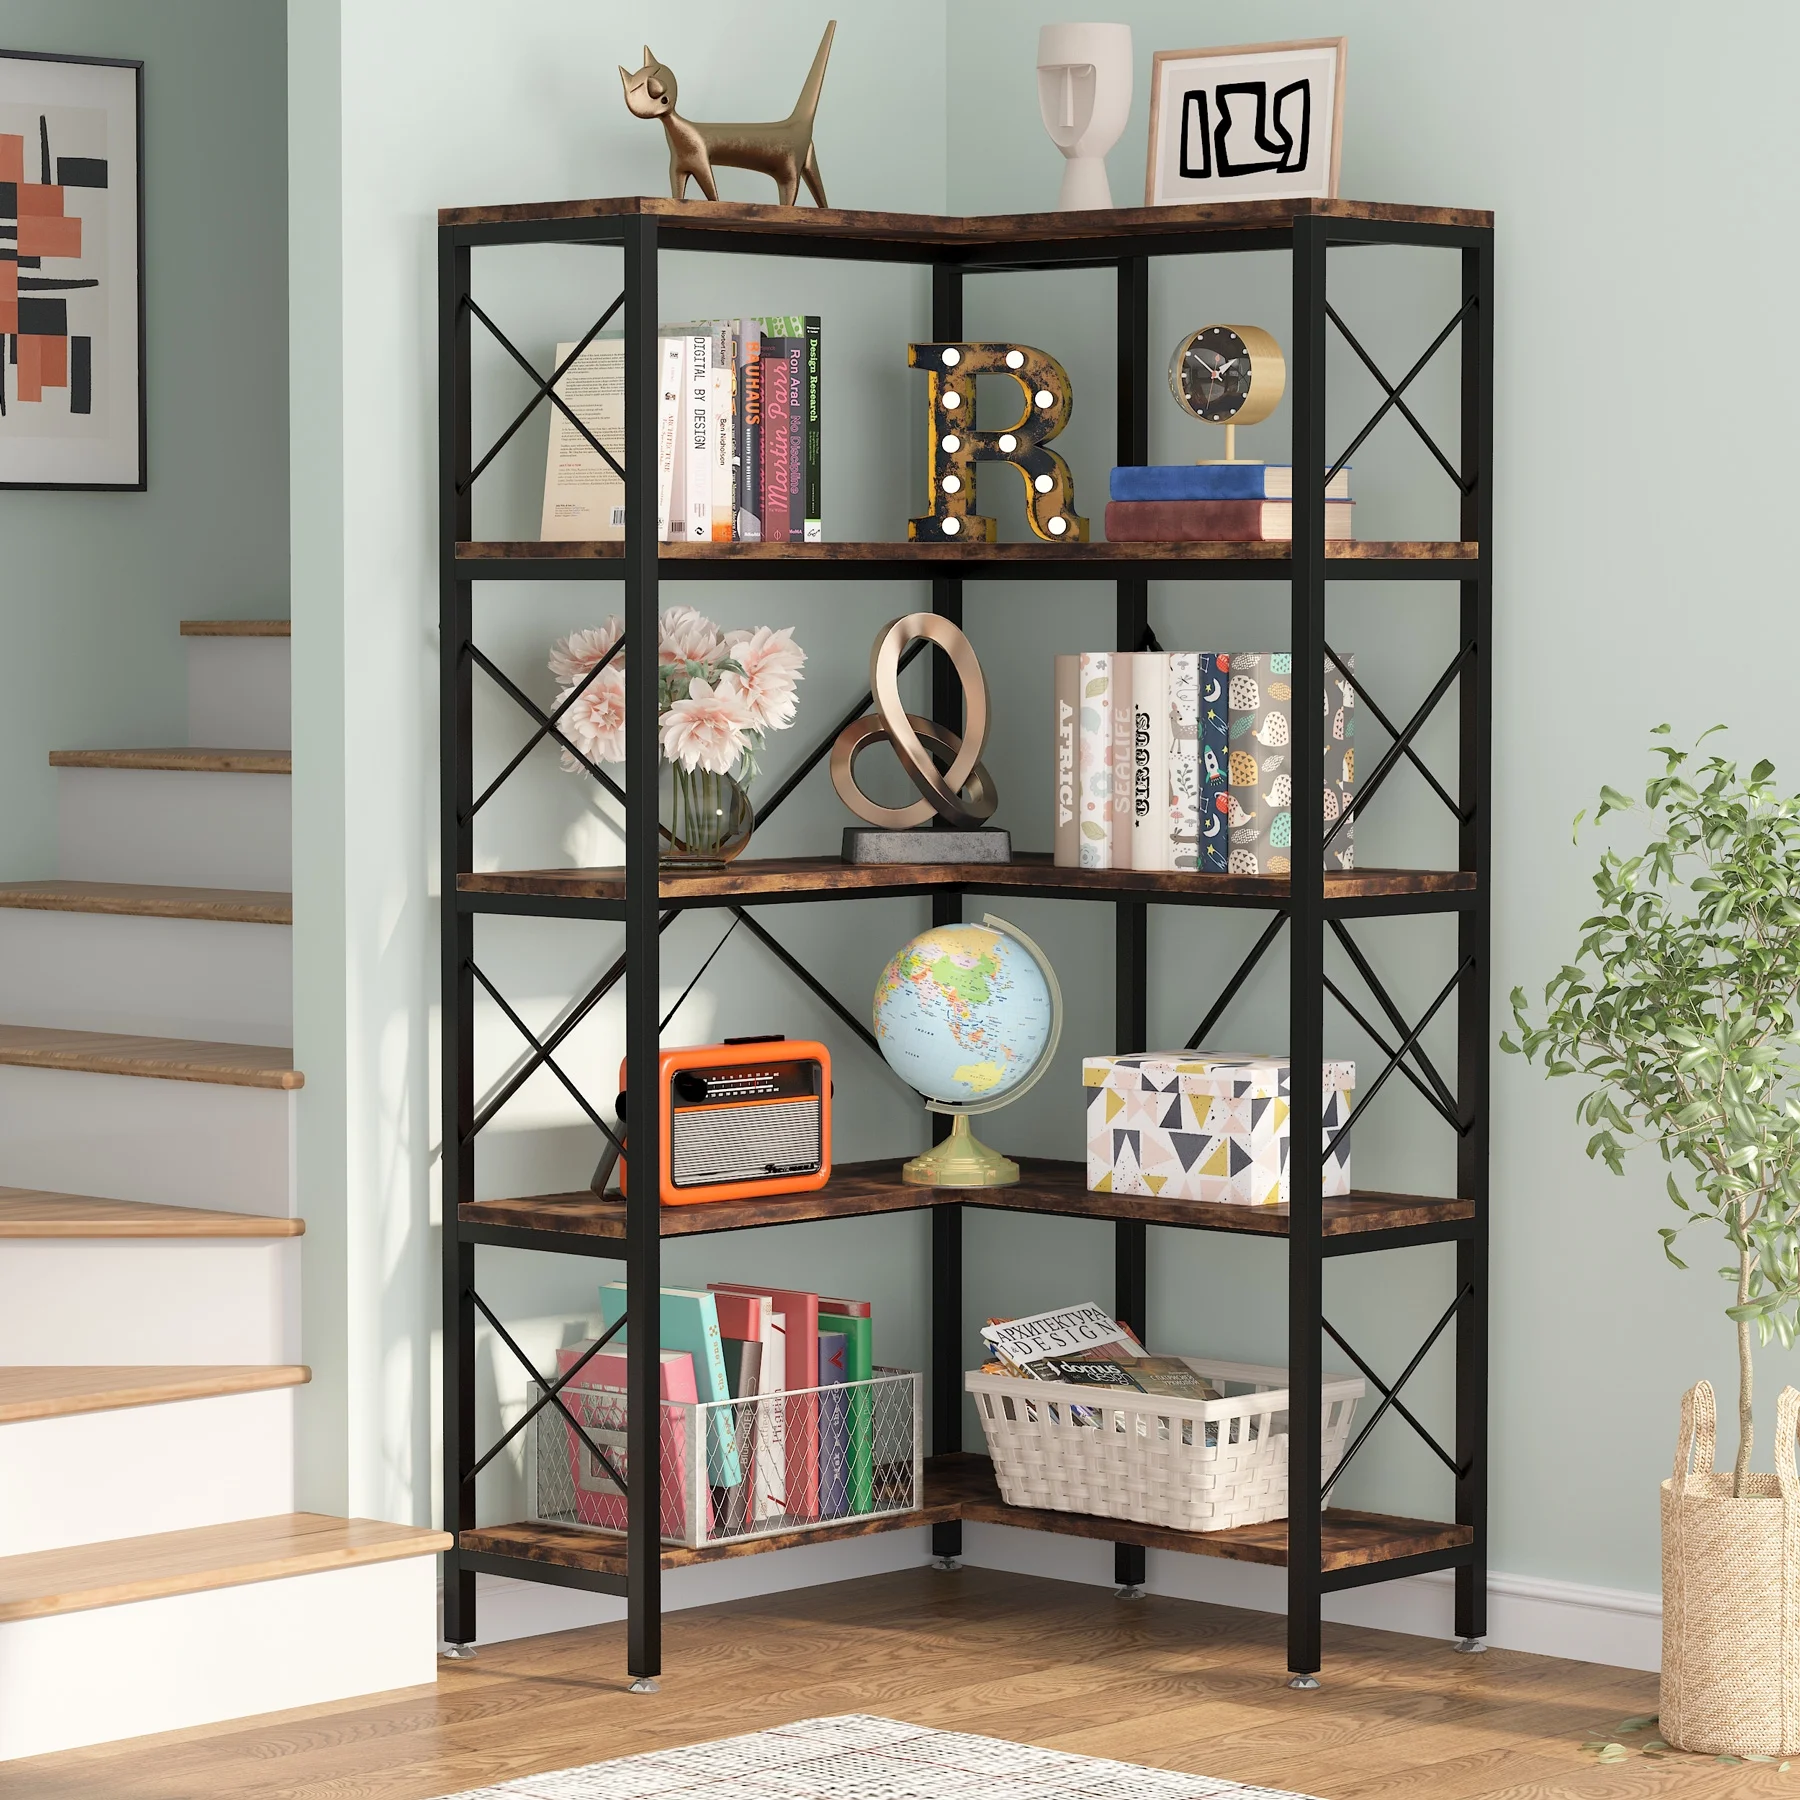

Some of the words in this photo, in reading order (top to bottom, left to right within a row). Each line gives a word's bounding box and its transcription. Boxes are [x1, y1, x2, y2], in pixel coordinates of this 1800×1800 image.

[693, 337, 706, 382] DIGITAL
[790, 349, 801, 374] Ron
[807, 338, 818, 374] Design
[693, 388, 706, 402] BY
[745, 341, 760, 425] BAUHAUS
[768, 361, 788, 419] Parr
[790, 377, 801, 407] Arad
[809, 375, 818, 422] Research
[693, 408, 706, 450] DESIGN
[790, 415, 801, 433] No
[719, 433, 727, 466] Nicholson
[908, 342, 1090, 543] R
[768, 426, 788, 509] Martin
[790, 435, 801, 495] Discipline
[1059, 699, 1074, 827] AFRICA
[1115, 706, 1131, 813] SEALIFE
[1135, 712, 1150, 817] CIRCUS
[995, 1307, 1107, 1343] АРХИТЕКТУРА
[1013, 1320, 1117, 1355] DESIGN
[716, 1372, 724, 1391] the
[1060, 1361, 1122, 1374] domus
[1087, 1372, 1134, 1386] design
[740, 1442, 750, 1465] Blue
